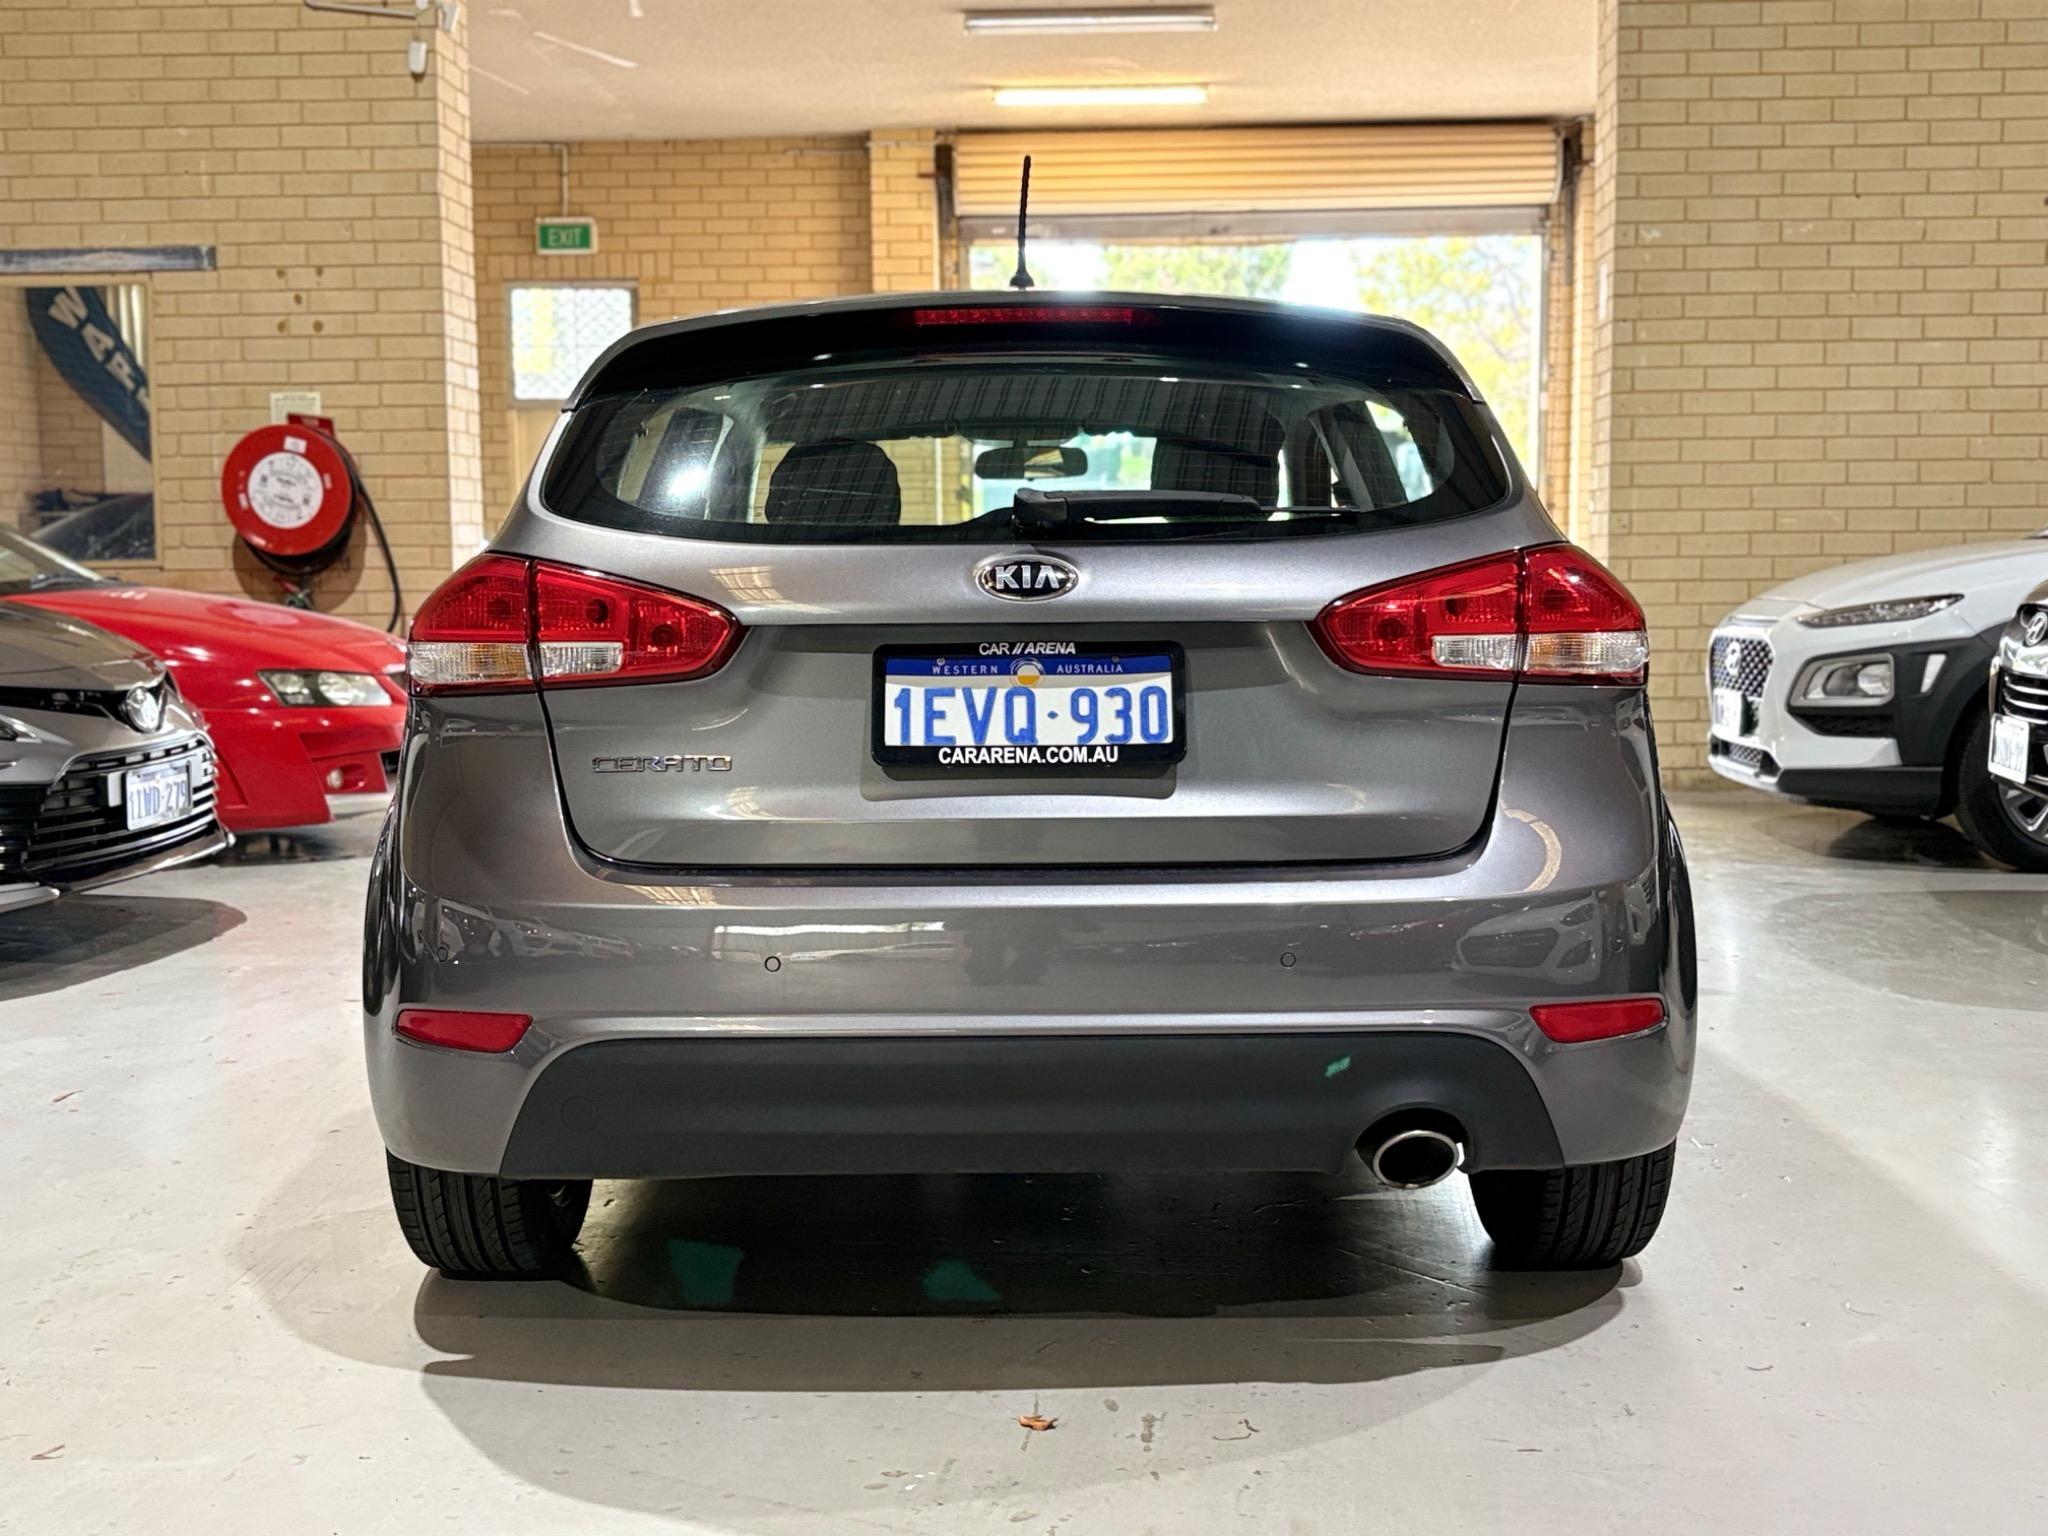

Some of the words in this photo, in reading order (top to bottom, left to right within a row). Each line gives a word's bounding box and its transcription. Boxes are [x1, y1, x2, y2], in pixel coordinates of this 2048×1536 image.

[547, 226, 582, 247] EXIT
[994, 564, 1060, 590] KIA
[932, 664, 999, 675] WESTERN
[1056, 663, 1123, 674] AUSTRALIA
[591, 754, 733, 773] CERATO
[938, 746, 1119, 764] CARARENA.COM.AU
